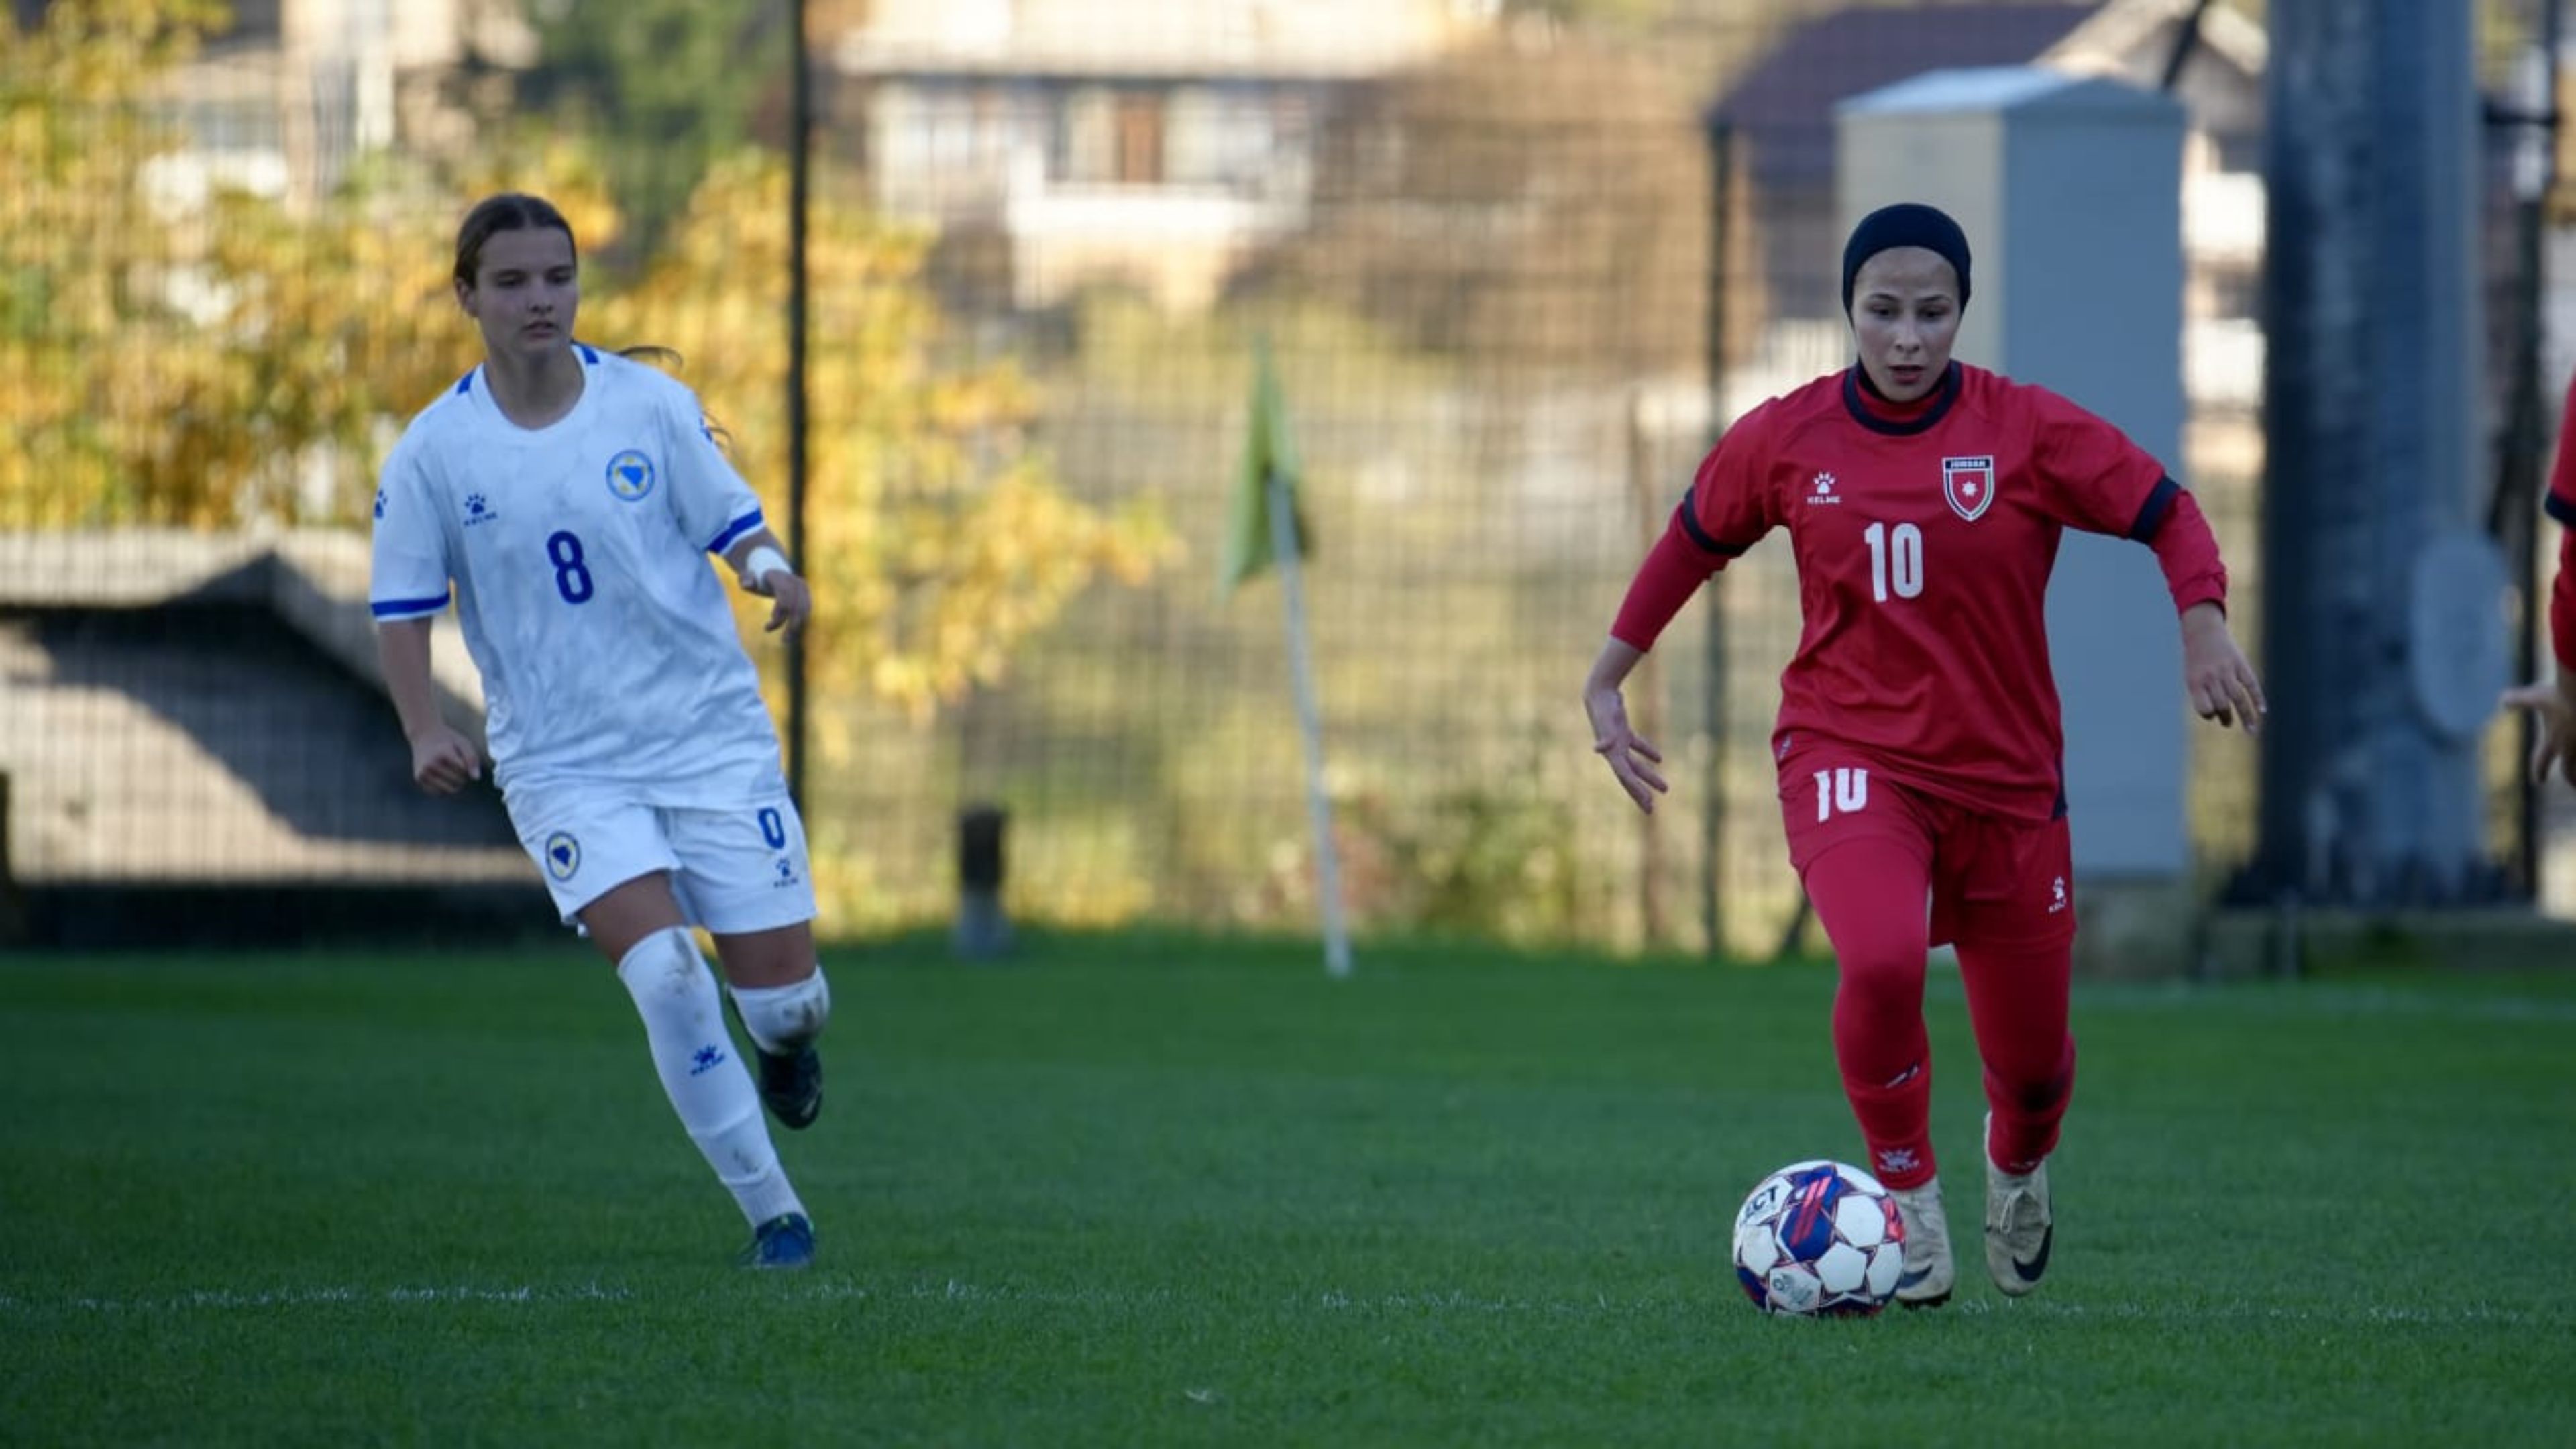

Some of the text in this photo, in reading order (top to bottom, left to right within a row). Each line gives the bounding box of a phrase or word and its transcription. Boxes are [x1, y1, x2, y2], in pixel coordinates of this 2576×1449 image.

[547, 529, 594, 605] 8
[1864, 521, 1923, 602] 10
[1813, 768, 1868, 822] 10
